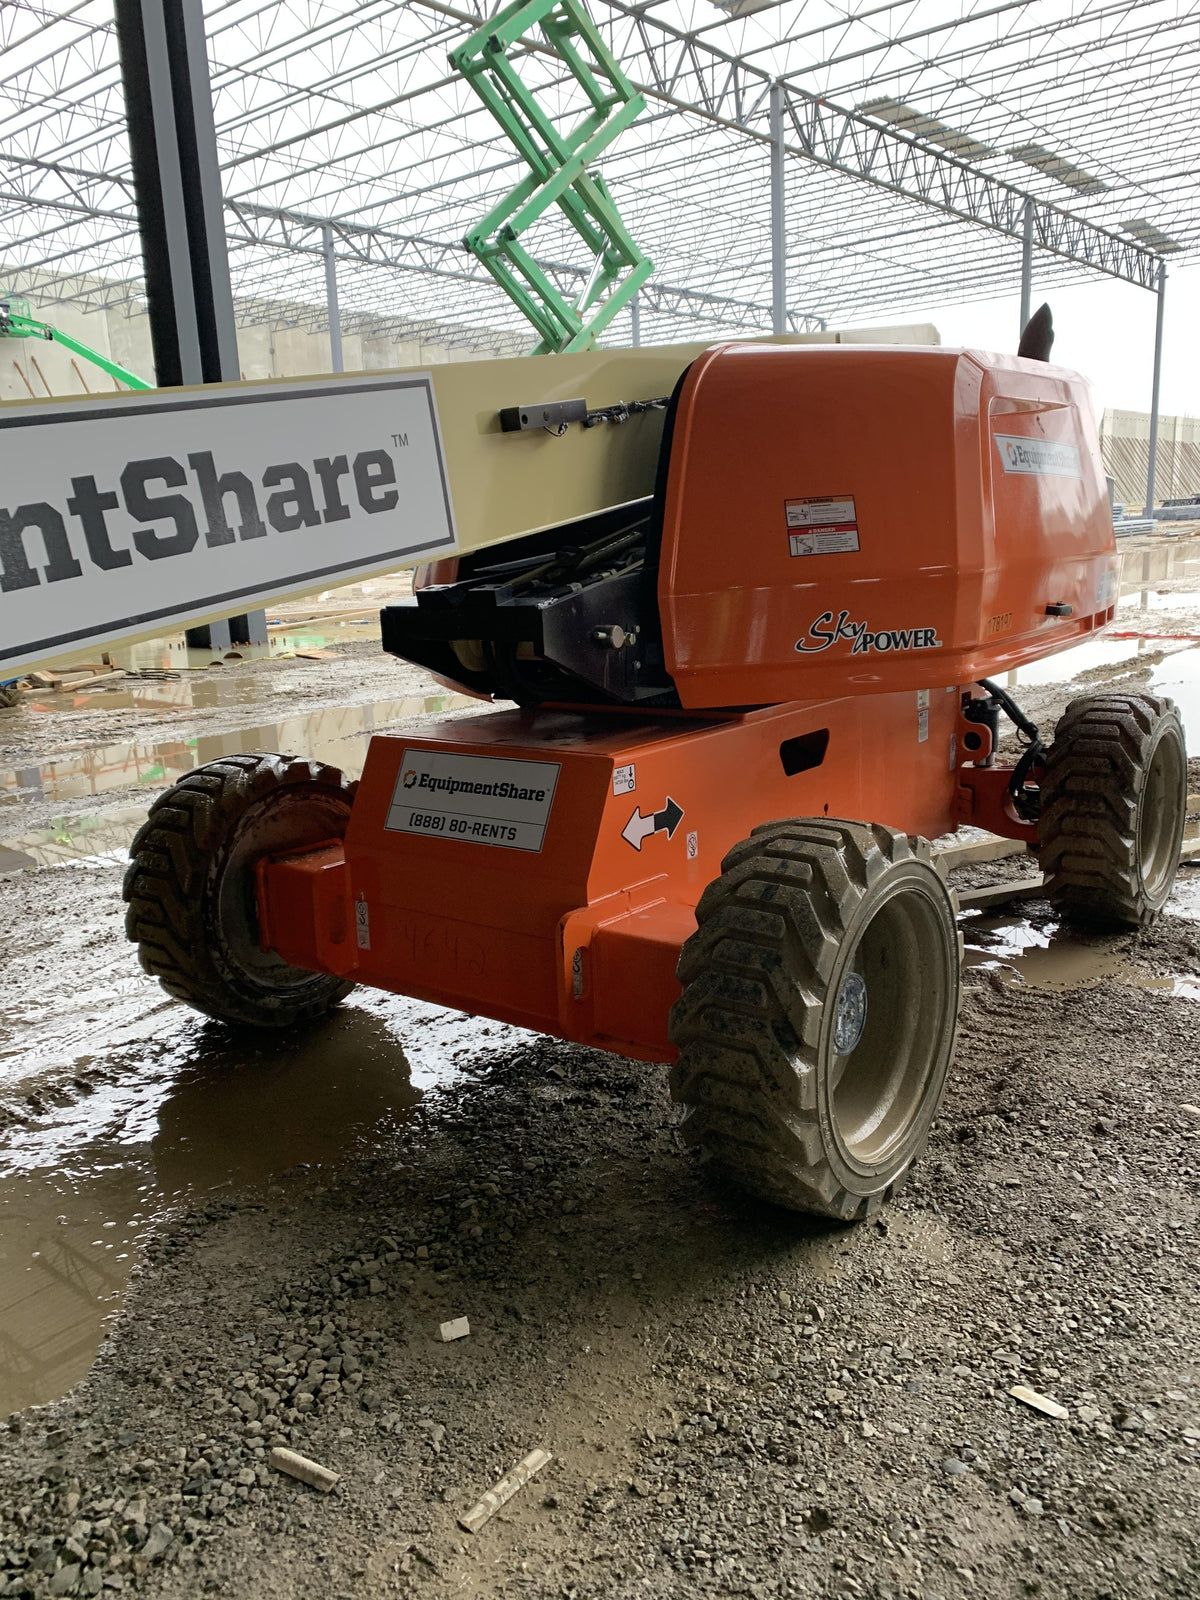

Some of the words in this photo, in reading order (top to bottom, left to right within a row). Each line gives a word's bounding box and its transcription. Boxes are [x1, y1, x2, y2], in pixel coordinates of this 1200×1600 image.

[418, 773, 546, 802] EquipmentShare
[409, 812, 446, 831] (888)
[448, 819, 517, 841] 80-RENTS
